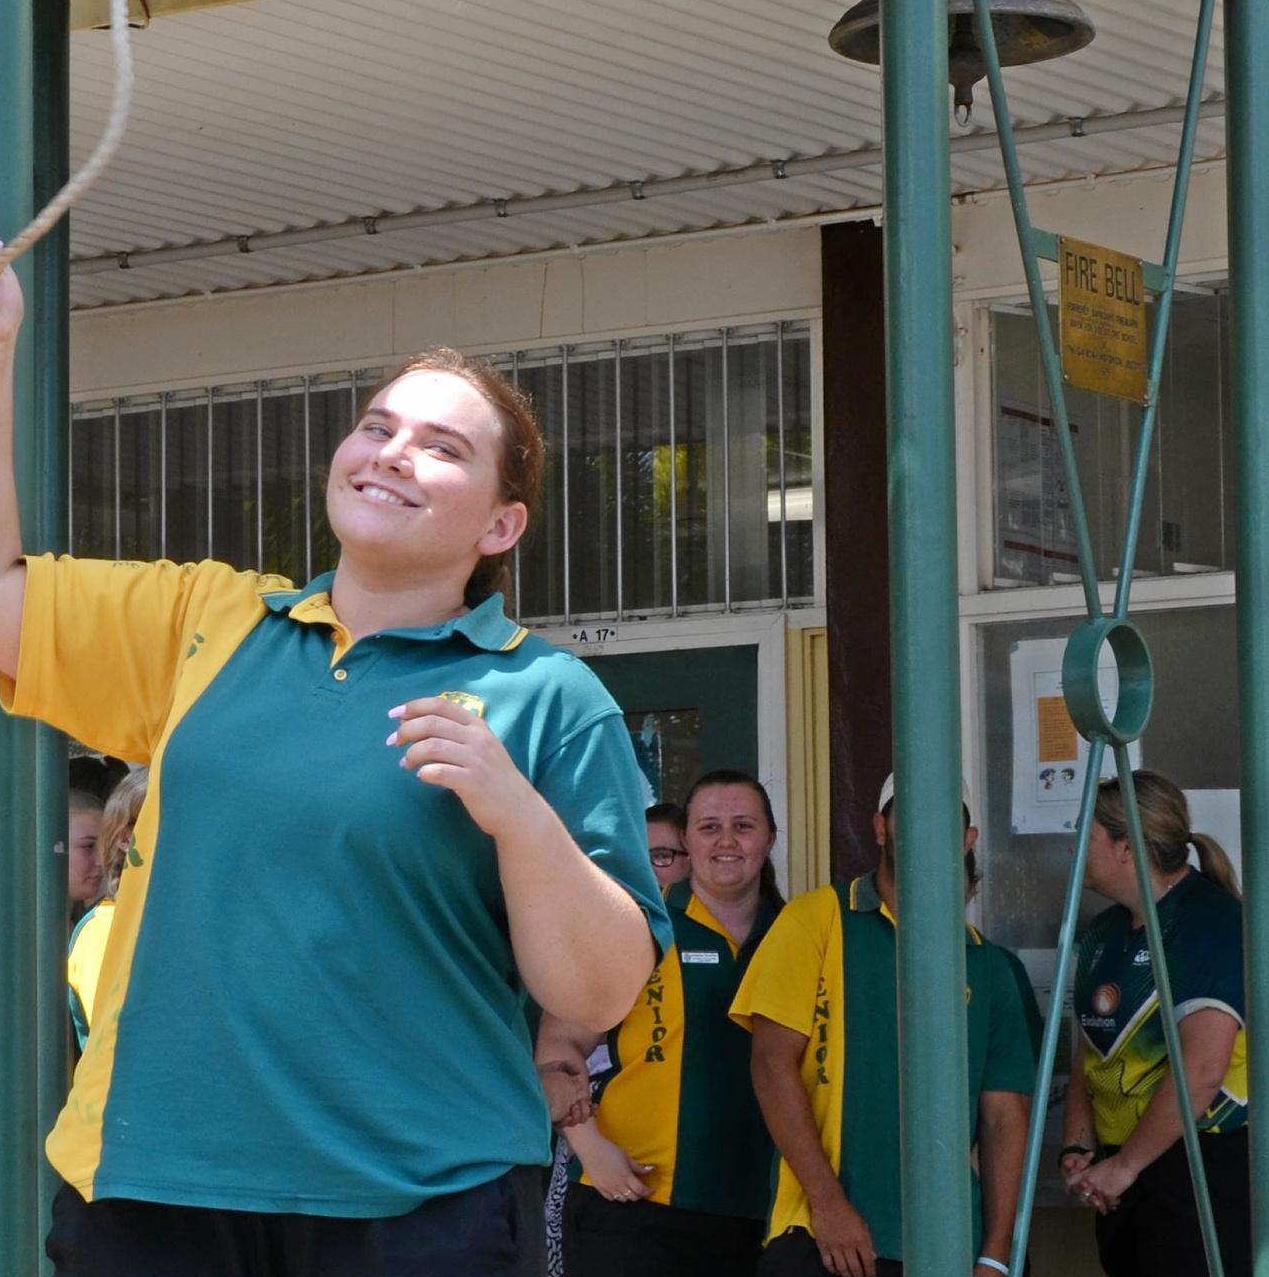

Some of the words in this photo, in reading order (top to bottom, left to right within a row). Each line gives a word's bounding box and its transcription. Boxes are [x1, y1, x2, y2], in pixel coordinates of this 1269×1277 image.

[1065, 251, 1098, 294] FIRE
[1104, 263, 1140, 306] BELL
[579, 629, 588, 642] A
[595, 628, 609, 641] 17
